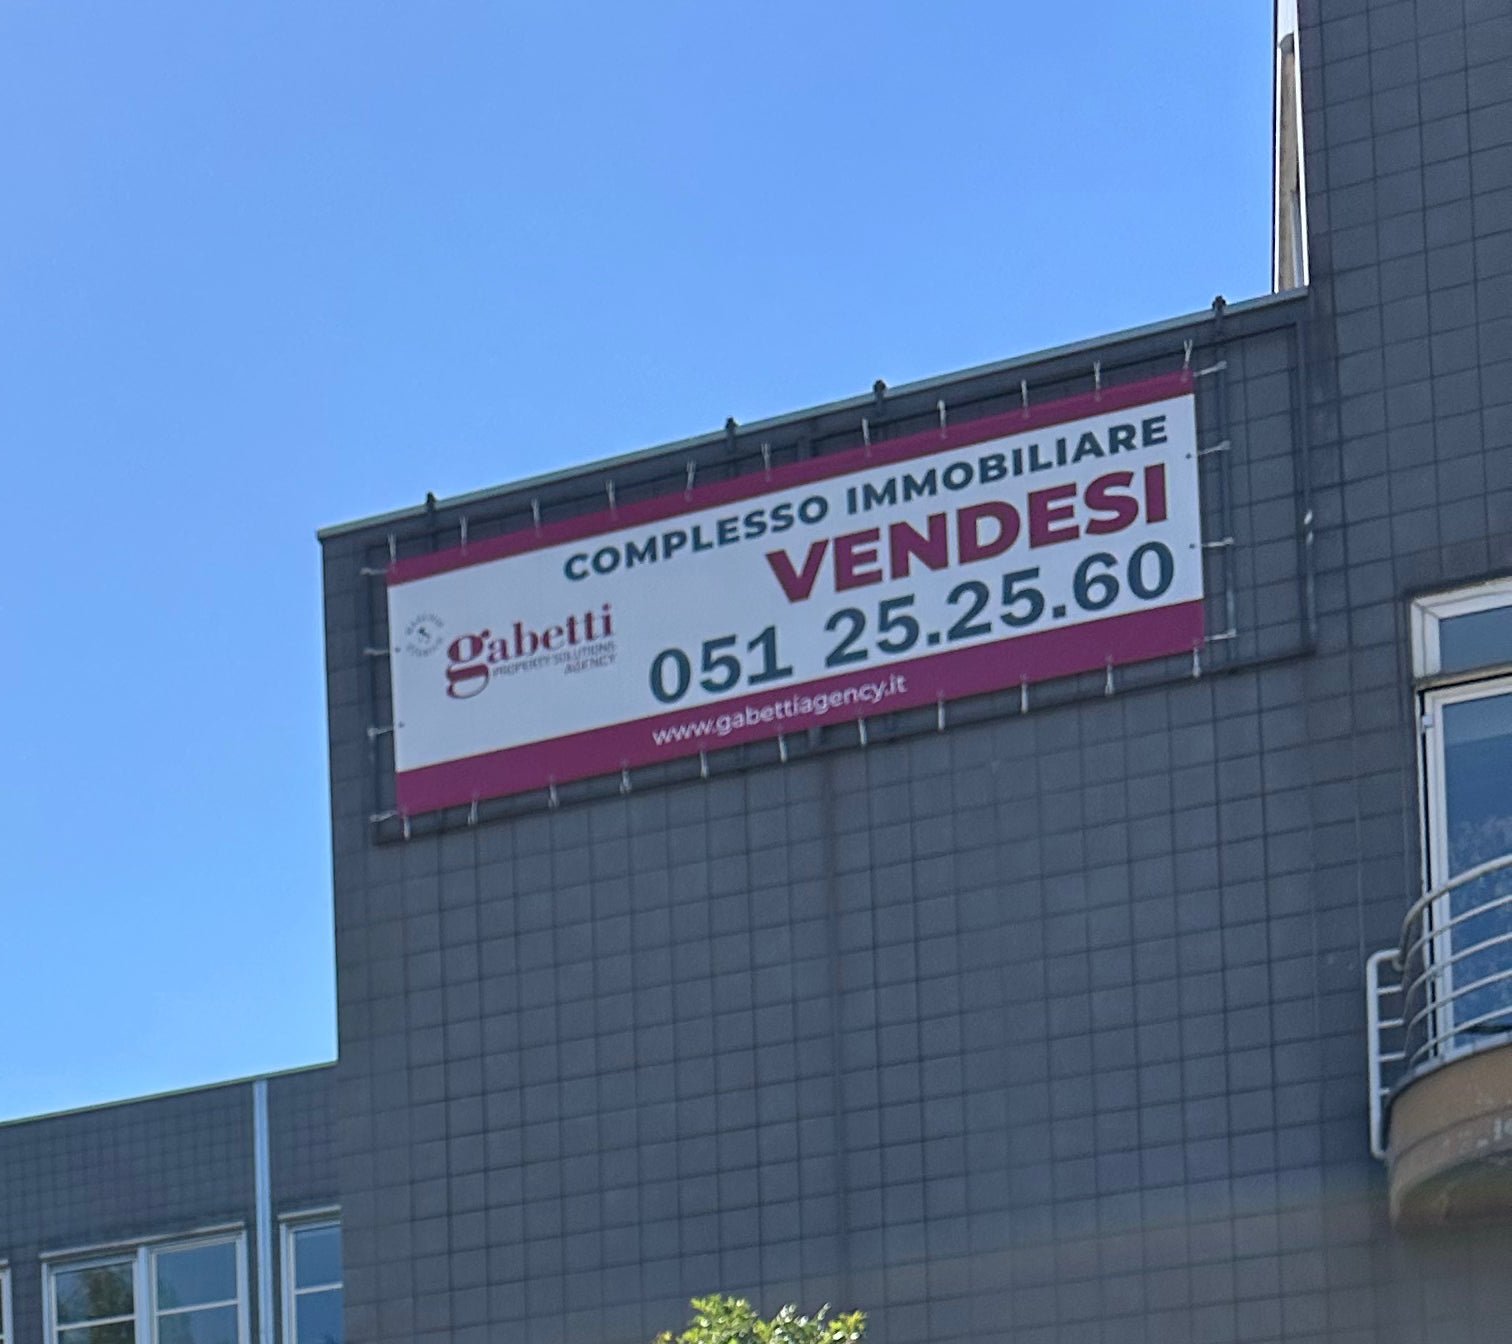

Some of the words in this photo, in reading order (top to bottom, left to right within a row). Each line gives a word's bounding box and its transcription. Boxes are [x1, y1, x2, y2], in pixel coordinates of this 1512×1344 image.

[563, 495, 830, 583] COMPLESSO
[846, 414, 1169, 516] IMMOBILIARE
[765, 462, 1169, 604] VENDESI
[445, 602, 617, 700] gabetti
[649, 624, 794, 705] 051
[823, 540, 1176, 668] 25.25.60
[652, 673, 908, 747] www.gabettiagency.it
